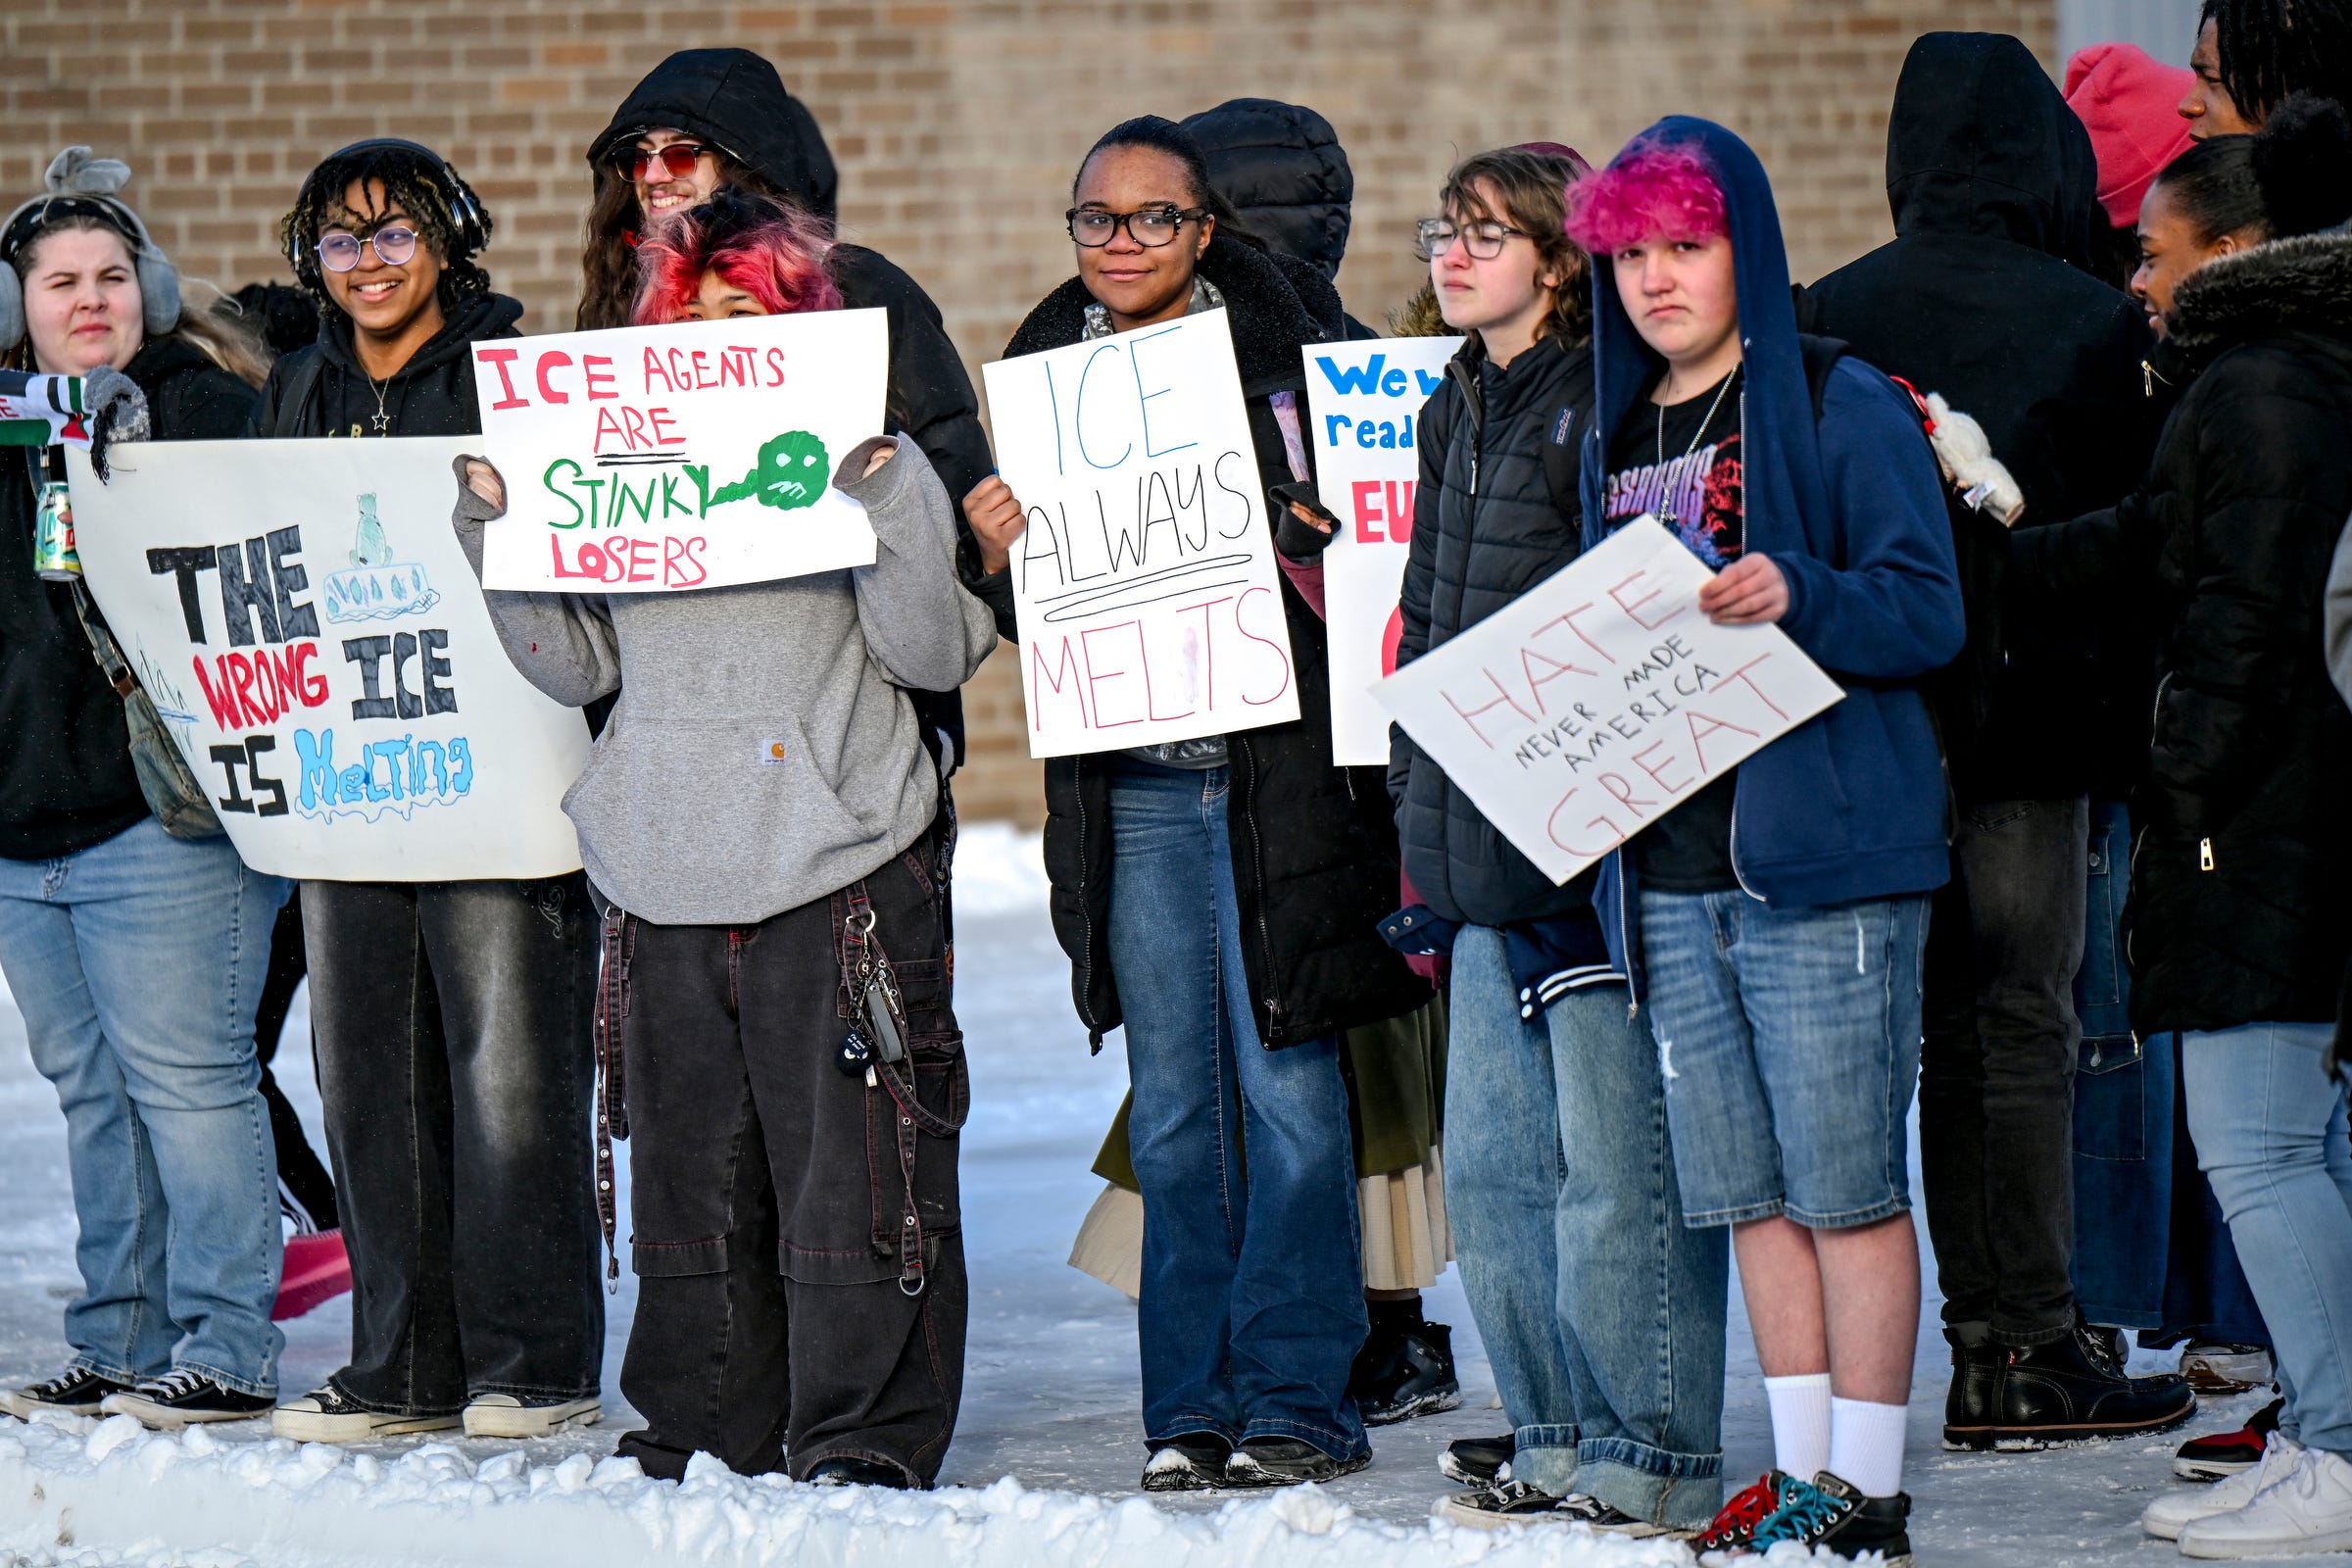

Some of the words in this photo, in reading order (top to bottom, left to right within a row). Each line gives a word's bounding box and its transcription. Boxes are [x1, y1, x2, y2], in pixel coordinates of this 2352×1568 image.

[476, 348, 619, 410] ICE
[643, 346, 785, 395] AGENTS
[1046, 326, 1198, 475] ICE
[1315, 354, 1408, 398] We
[594, 407, 687, 454] ARE
[544, 459, 710, 529] STINKY
[1022, 451, 1251, 594] ALWAYS
[1351, 480, 1420, 544] EU
[145, 524, 321, 648] THE
[551, 533, 708, 588] LOSERS
[193, 641, 329, 733] WRONG
[342, 629, 459, 721] ICE
[1032, 587, 1290, 731] MELTS
[1440, 570, 1686, 750] HATE
[1513, 701, 1597, 770] NEVER
[1623, 633, 1694, 691] MADE
[1546, 652, 1790, 858] GREAT
[1561, 663, 1720, 774] AMERICA
[209, 735, 290, 817] IS
